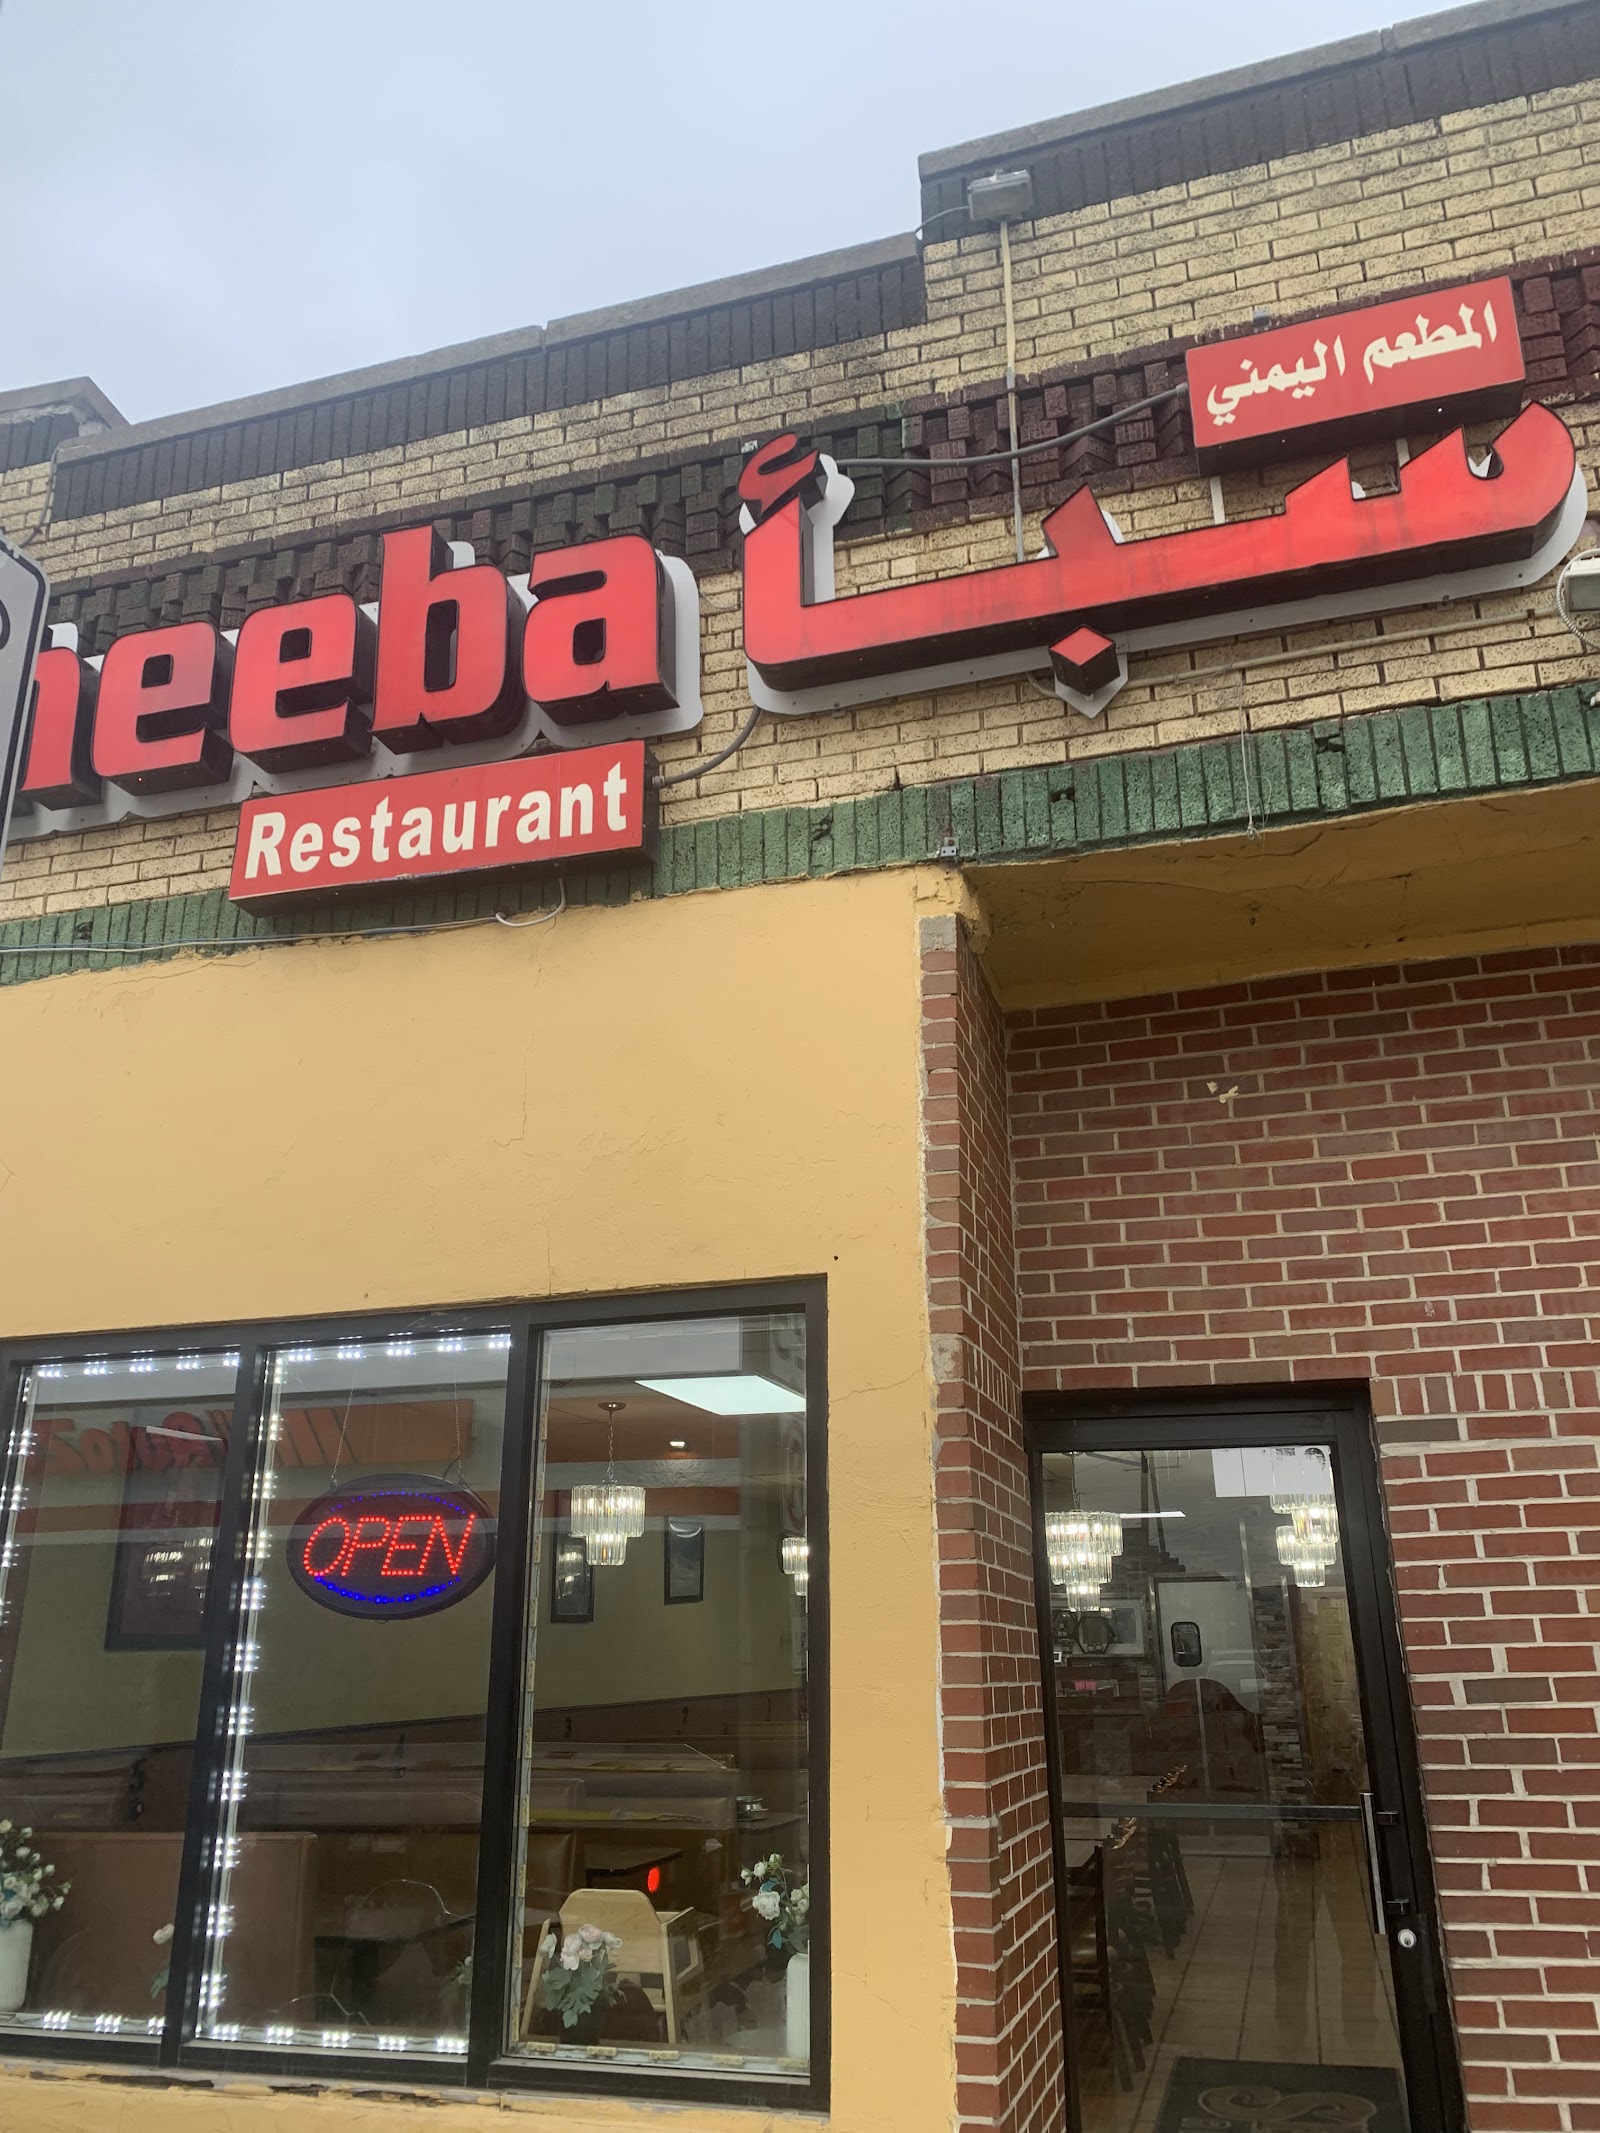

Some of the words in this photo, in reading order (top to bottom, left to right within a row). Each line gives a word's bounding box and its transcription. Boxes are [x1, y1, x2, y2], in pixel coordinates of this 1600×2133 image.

[1206, 334, 1346, 427] اليمني
[1363, 300, 1498, 385] المطعم
[245, 761, 628, 880] Restaurant
[303, 1513, 476, 1577] OPEN
